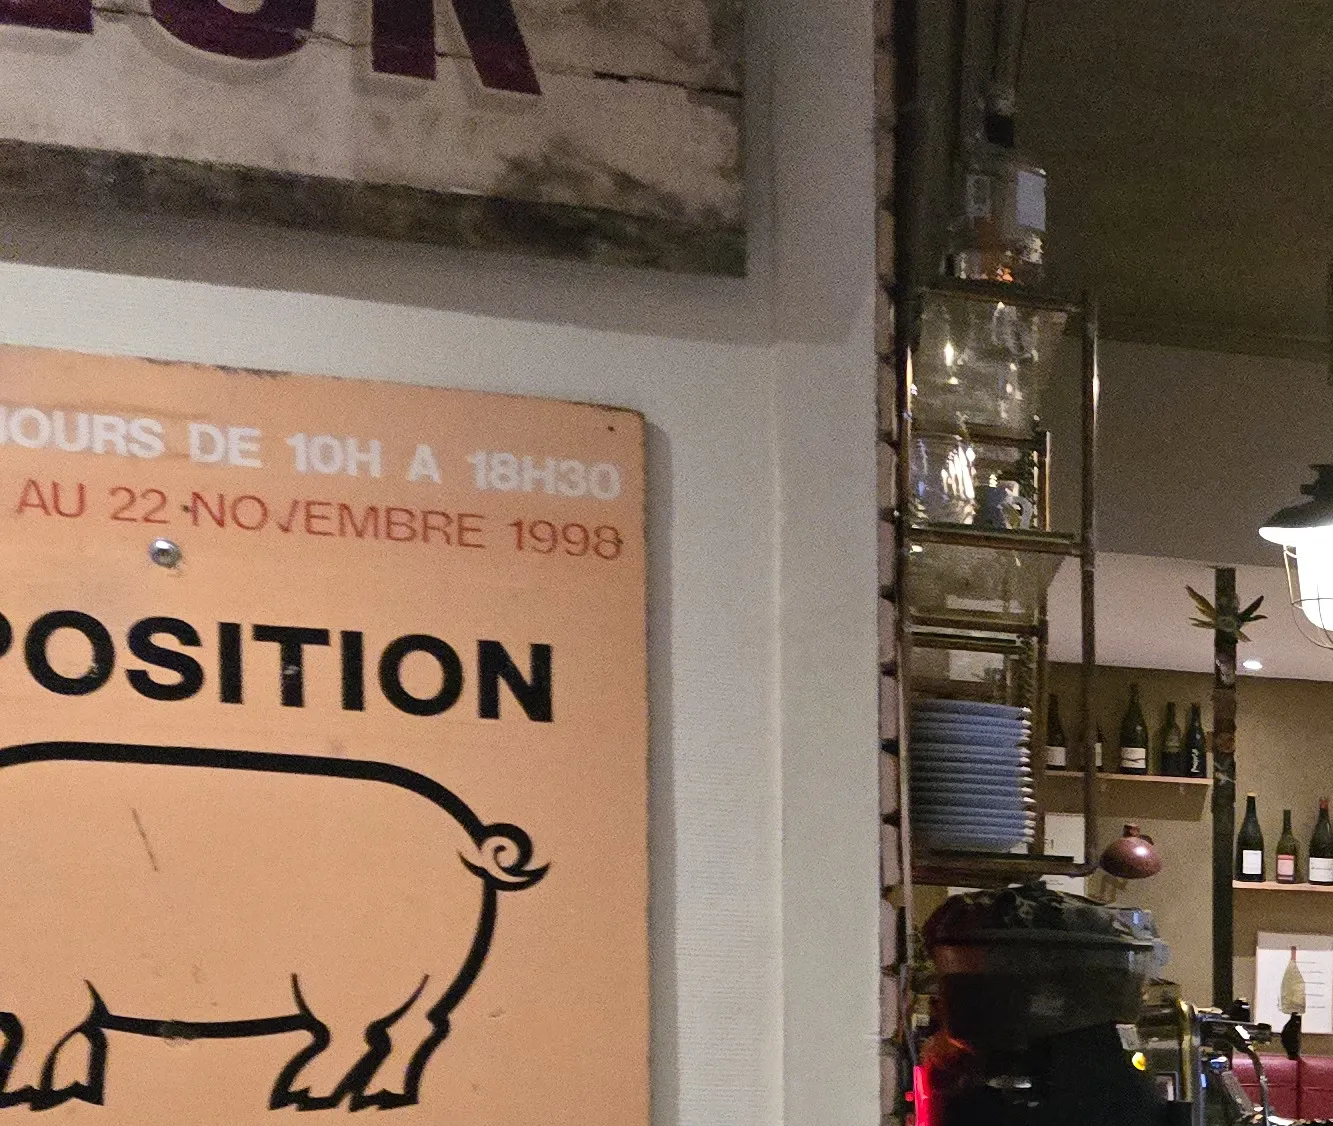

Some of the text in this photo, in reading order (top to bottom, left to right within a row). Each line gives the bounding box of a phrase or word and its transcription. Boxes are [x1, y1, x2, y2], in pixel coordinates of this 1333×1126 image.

[0, 407, 622, 501] OURS DE 10H A 18H30
[14, 478, 87, 518] AU
[108, 486, 170, 525] 22
[509, 517, 622, 561] 1998
[0, 609, 556, 723] OSITION
